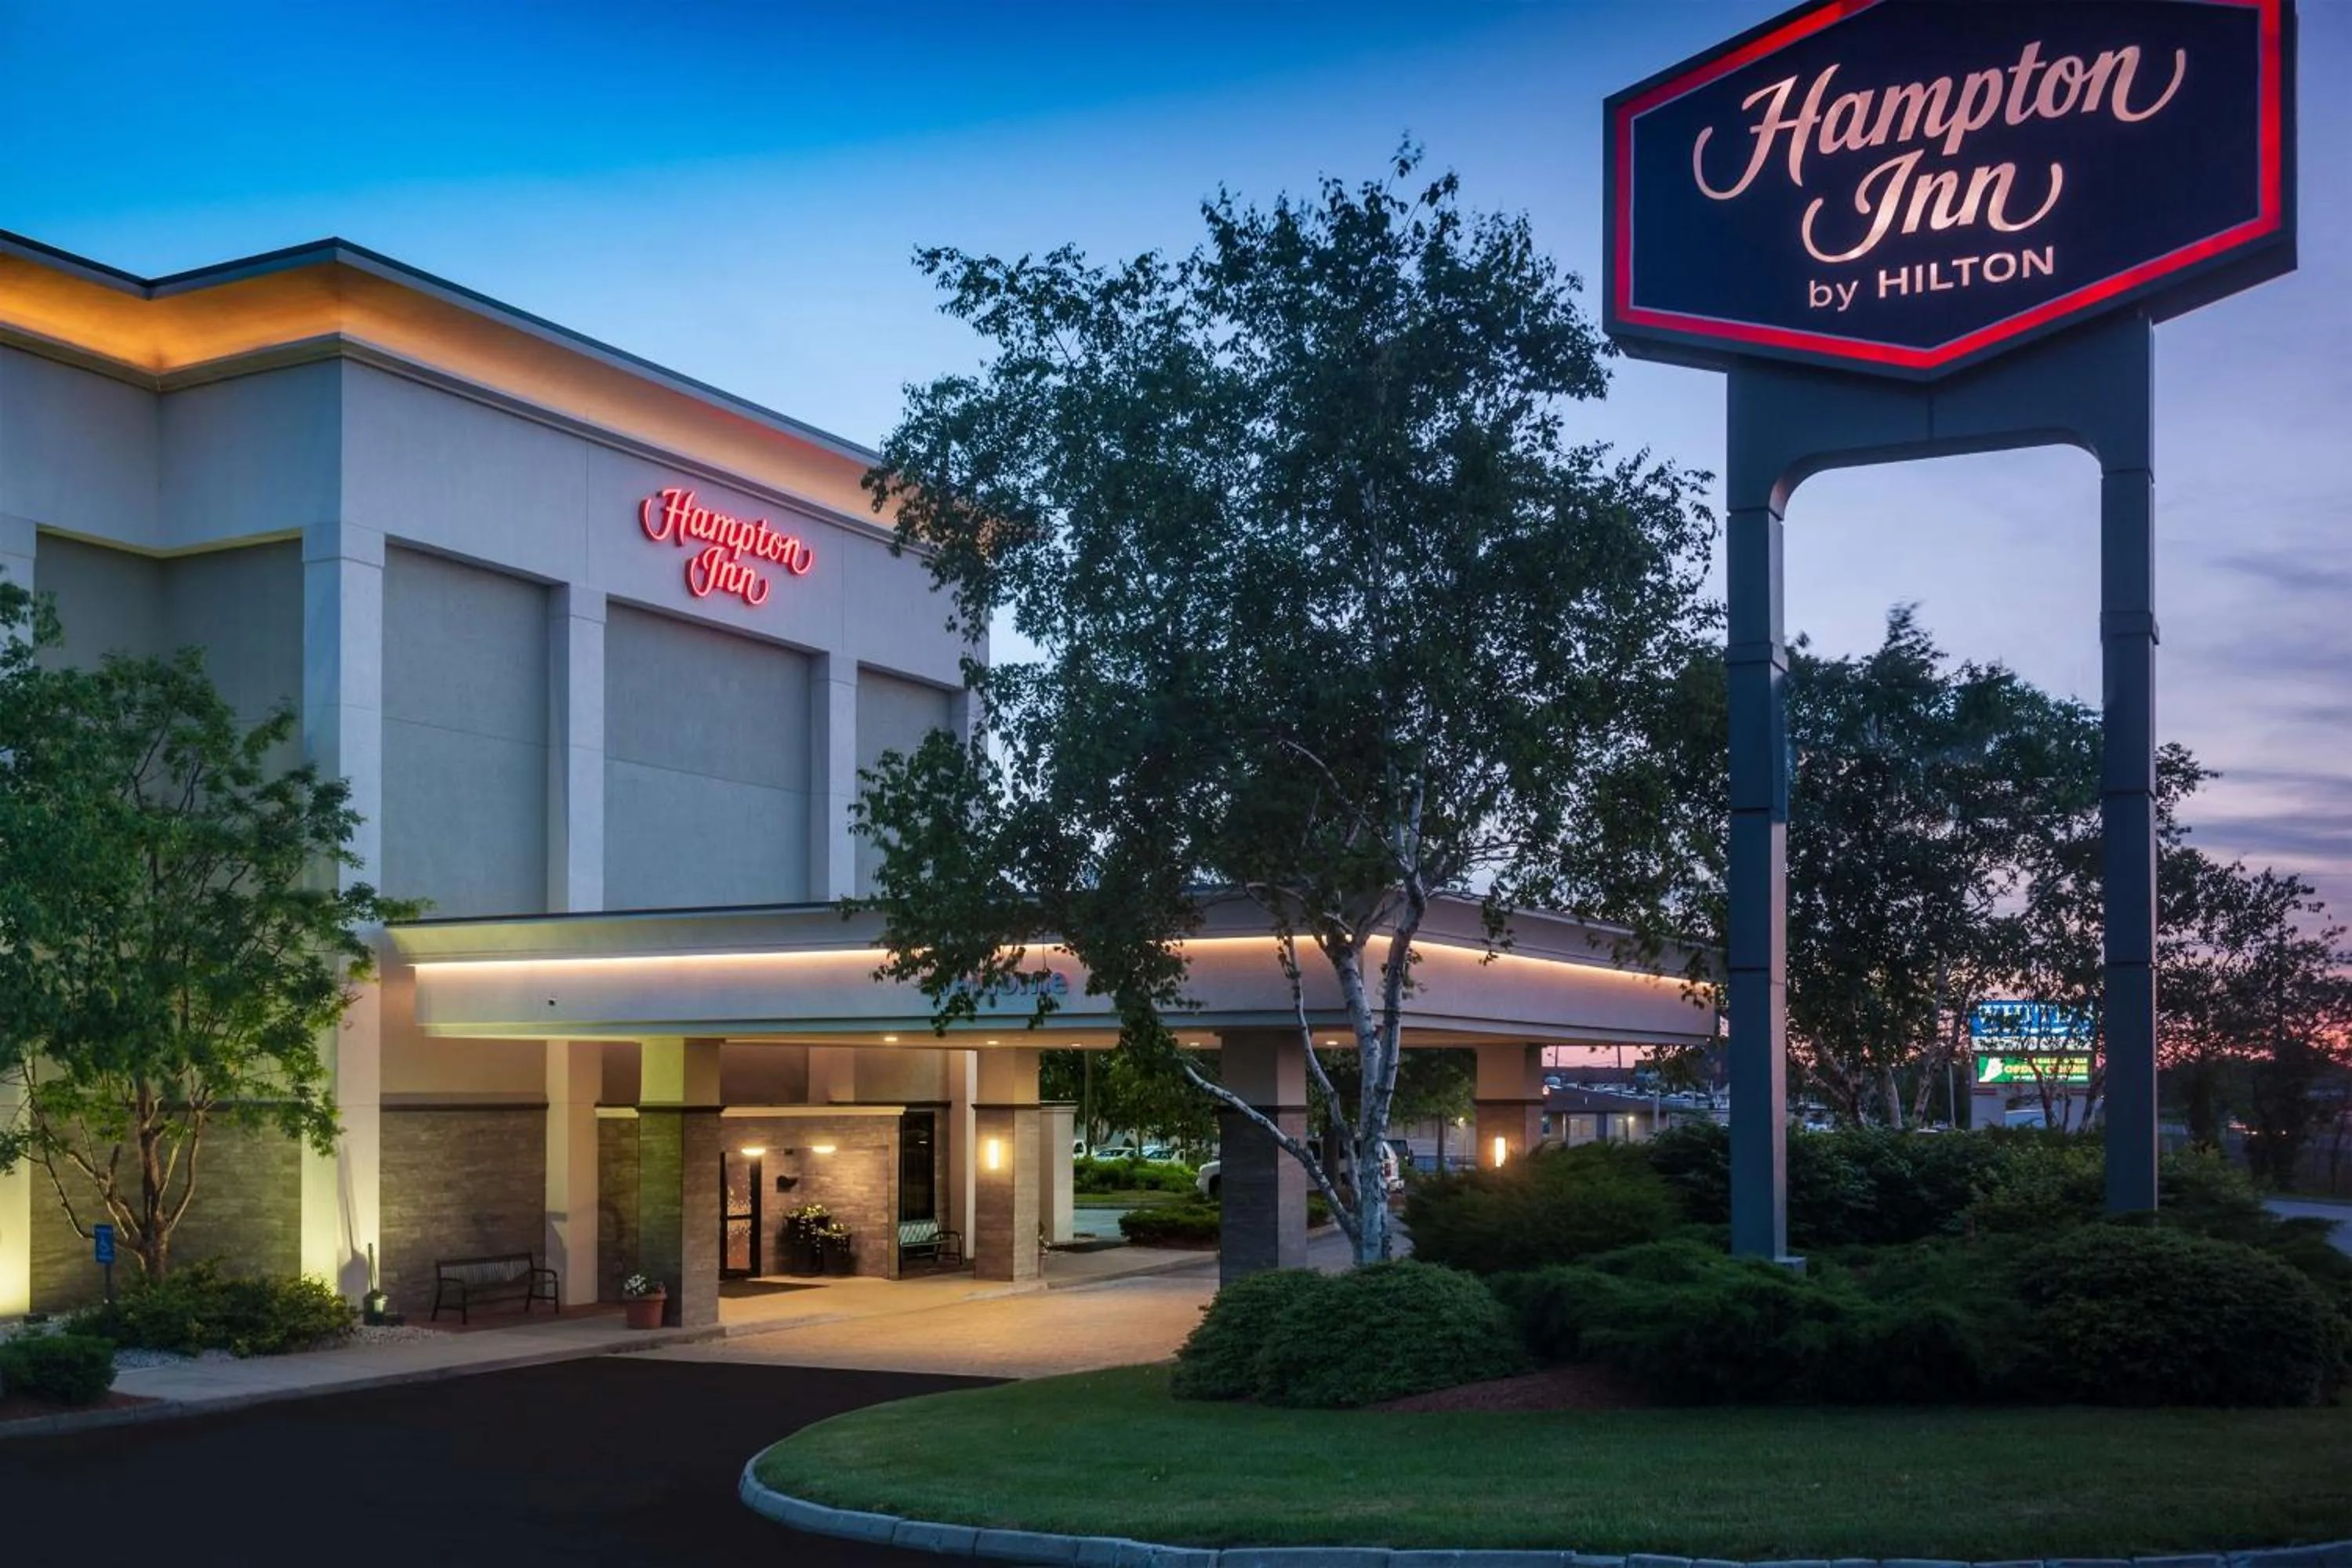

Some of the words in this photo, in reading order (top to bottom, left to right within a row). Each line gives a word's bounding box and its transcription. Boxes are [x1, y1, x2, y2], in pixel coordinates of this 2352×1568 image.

[1693, 42, 2185, 199] Hampton
[1802, 149, 2063, 263] Inn
[1809, 280, 1858, 311] by
[1878, 246, 2054, 298] HILTON
[640, 488, 813, 575] Hampton
[685, 546, 769, 604] Inn
